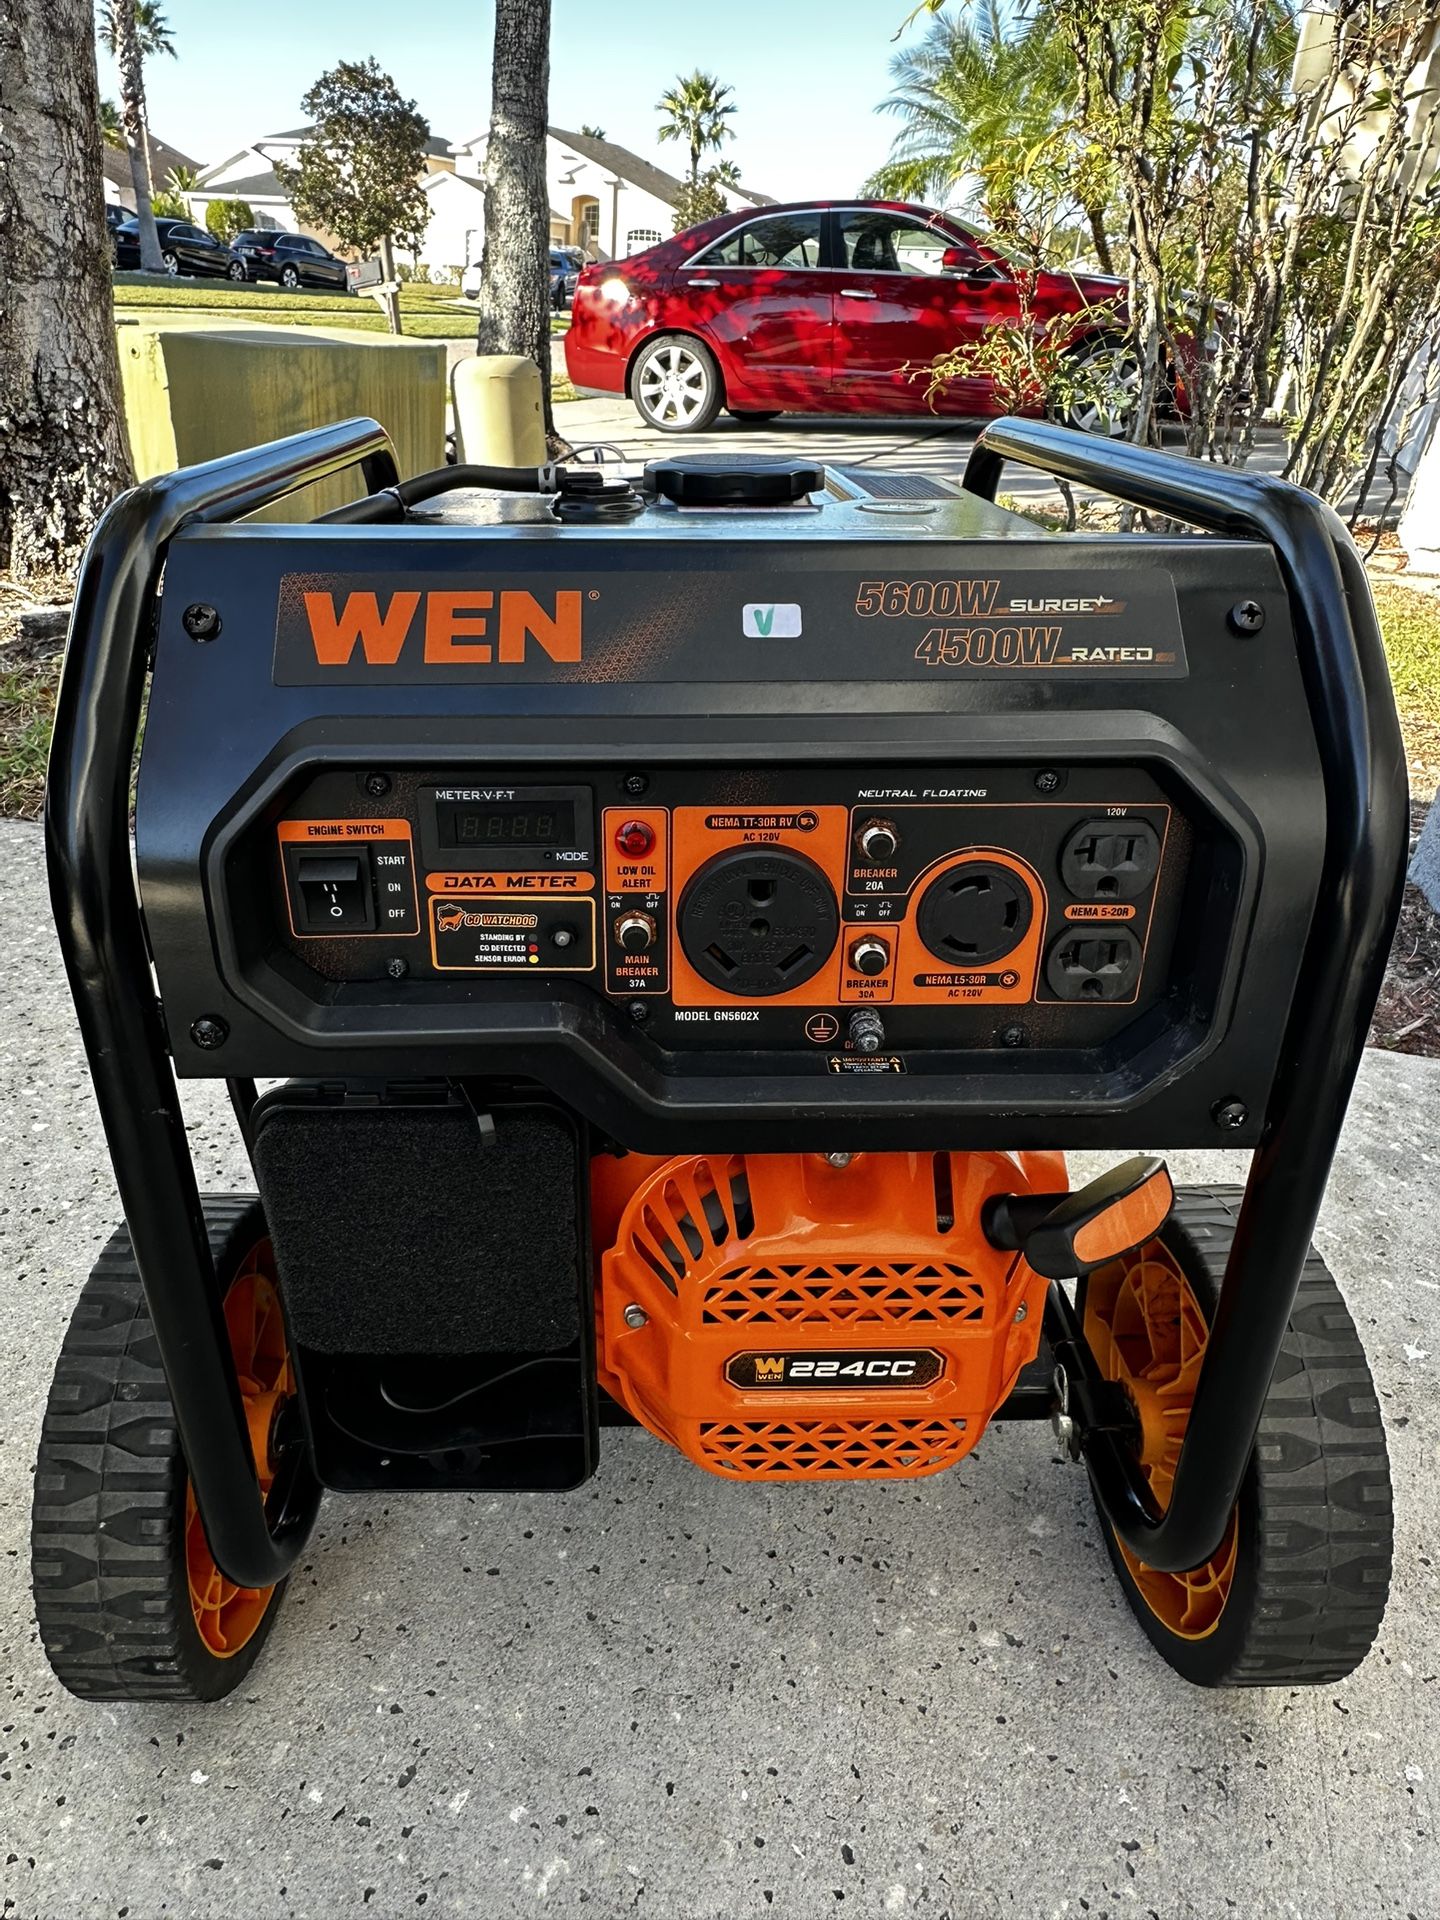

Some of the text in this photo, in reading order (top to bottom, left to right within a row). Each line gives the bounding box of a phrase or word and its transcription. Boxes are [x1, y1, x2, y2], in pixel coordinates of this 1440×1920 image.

[854, 580, 1095, 617] 5600W SURGE
[303, 590, 583, 664] WEN
[914, 627, 1153, 666] 4500W RATED
[857, 789, 988, 798] NEUTRAL FLOATING
[1106, 807, 1128, 816] 120V
[711, 817, 793, 827] NEMA TT-30R RV
[307, 824, 385, 836] ENGINE SWITCH
[743, 832, 780, 842] AC 120V
[376, 855, 406, 866] START
[556, 851, 589, 861] MODE
[617, 865, 656, 876] LOW OIL
[853, 868, 898, 878] BREAKER
[444, 875, 577, 888] DATA METER
[621, 878, 652, 888] ALERT
[865, 881, 884, 891] 20A
[387, 882, 401, 892] ON
[610, 901, 621, 909] ON
[646, 901, 659, 909] OFF
[388, 908, 406, 918] OFF
[855, 909, 866, 917] ON
[878, 909, 891, 917] OFF
[1070, 906, 1129, 917] NEMA 5-20R
[465, 914, 537, 926] CO WATCHDOG
[480, 933, 515, 941] STANDING
[480, 944, 527, 952] CO DETECTED
[474, 955, 527, 963] SENSOR ERROR
[624, 955, 650, 964] MAIN
[615, 967, 659, 976] BREAKER
[629, 979, 646, 988] 37A
[846, 979, 889, 989] BREAKER
[925, 975, 987, 985] NEMA L5-30R
[858, 990, 875, 999] 30A
[947, 989, 983, 998] AC 120V
[674, 1011, 760, 1021] MODEL GN5602X
[788, 1360, 917, 1378] 224CC
